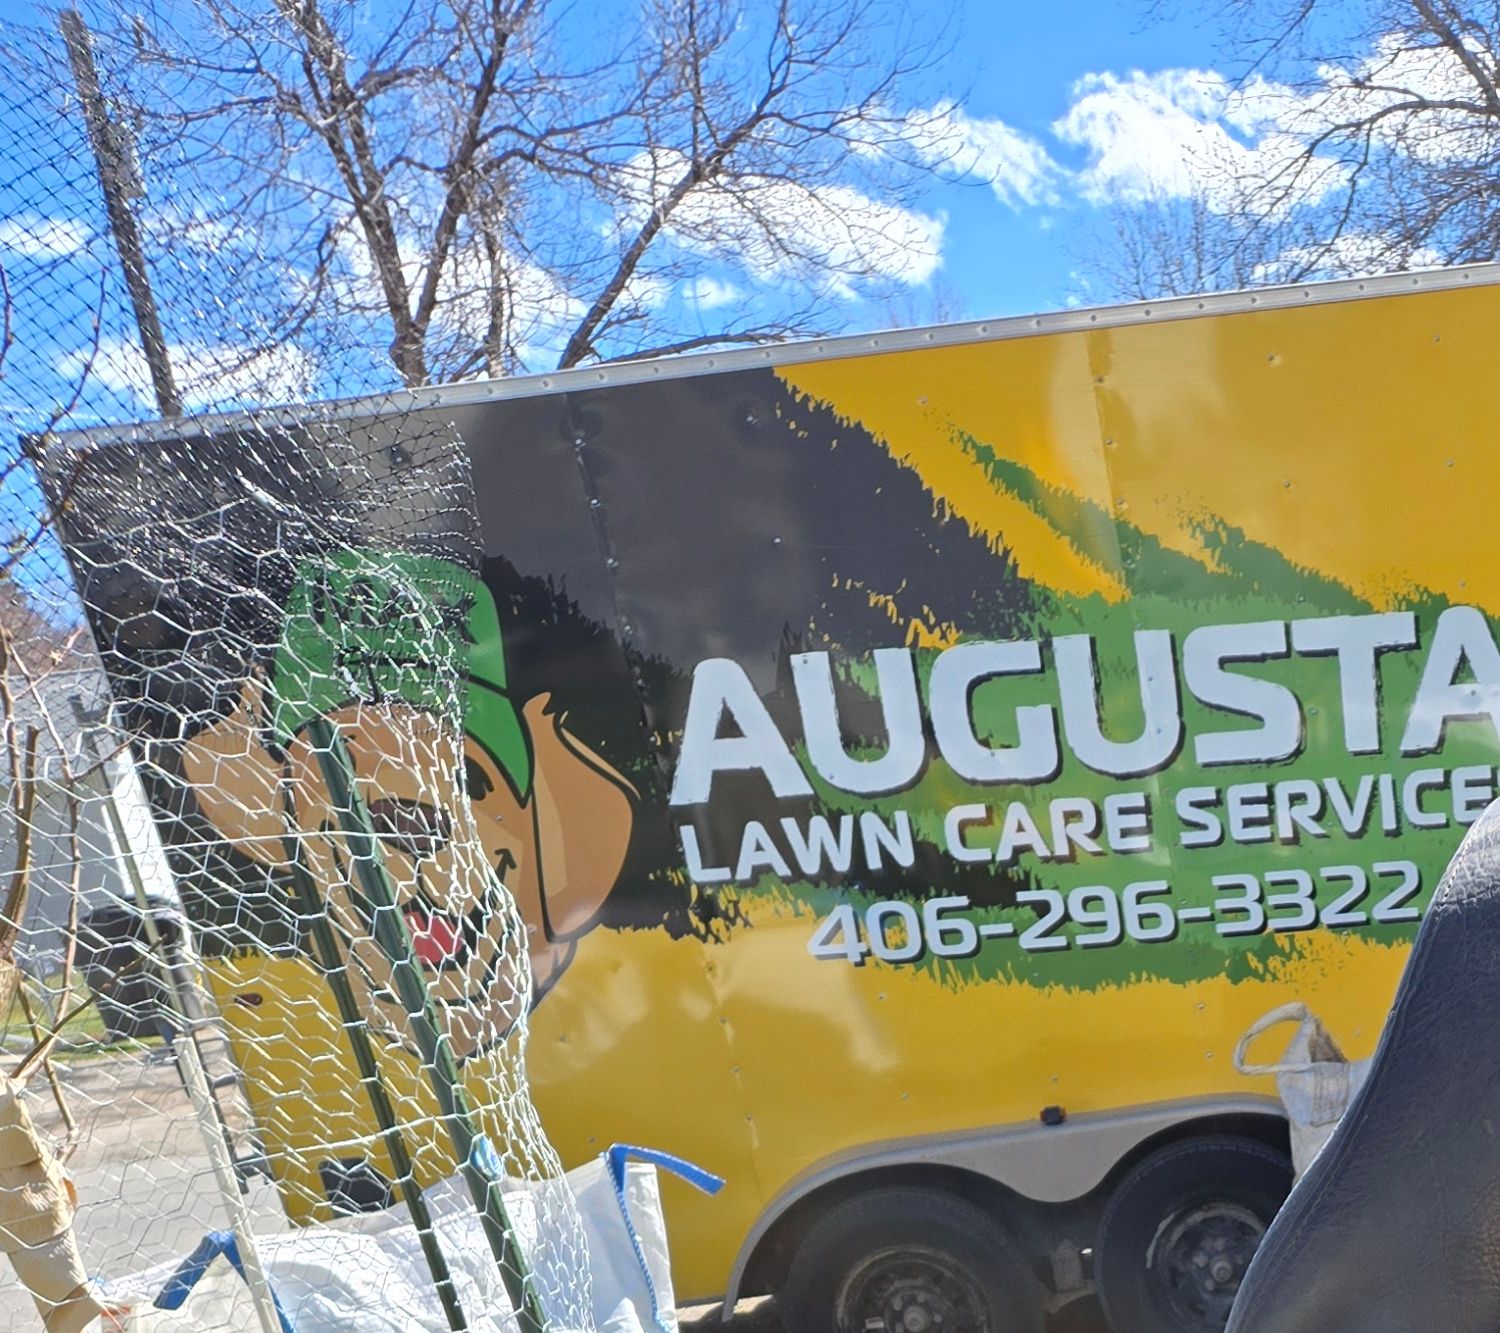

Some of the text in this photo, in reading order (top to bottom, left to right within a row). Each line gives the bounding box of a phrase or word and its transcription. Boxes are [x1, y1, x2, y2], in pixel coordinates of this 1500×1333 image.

[679, 810, 916, 883] LAWN
[944, 793, 1151, 863] CARE
[807, 860, 1421, 966] 406-296-3322
